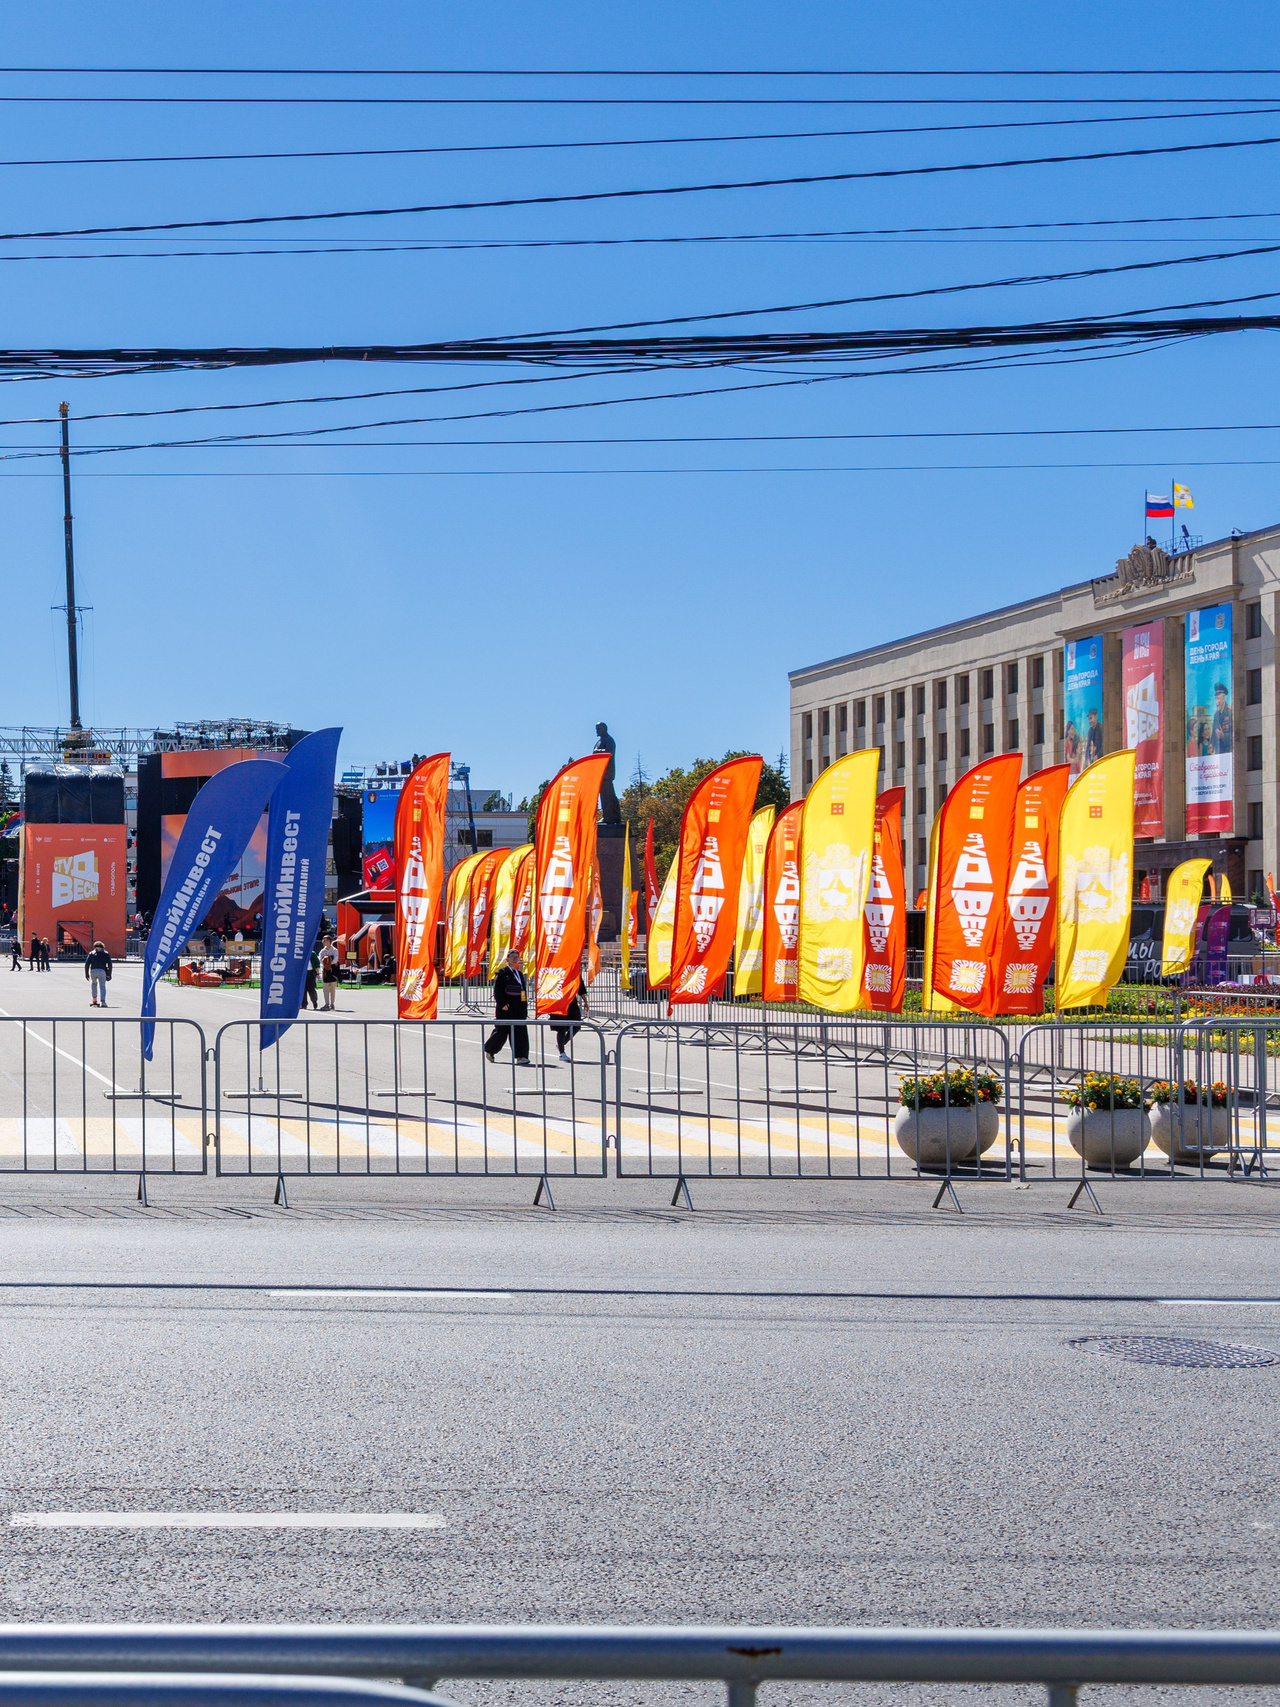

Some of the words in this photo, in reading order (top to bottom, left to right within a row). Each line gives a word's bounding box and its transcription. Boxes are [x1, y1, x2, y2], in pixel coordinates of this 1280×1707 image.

[1204, 641, 1228, 653] ГОРОДА
[1137, 762, 1160, 771] ГОРОДА
[1138, 771, 1152, 780] КРАЯ
[53, 850, 100, 884] СТУД
[402, 836, 428, 894] СТУД
[541, 835, 574, 896] СТУД
[690, 836, 725, 893] СТУД
[774, 860, 800, 904] СТУД
[866, 854, 894, 904] СТУД
[951, 832, 993, 889] СТУД
[1008, 840, 1049, 895] СТУД
[52, 872, 99, 908] ВЕСНА
[267, 810, 301, 1005] ЮгСтройИнвест
[297, 857, 310, 917] КОМПАНИЙ
[293, 919, 307, 960] ГРУППА
[773, 905, 799, 949] ВЕСНА
[864, 904, 895, 953] ВЕСНА
[950, 889, 995, 948] ВЕСНА
[1006, 896, 1050, 951] ВЕСНА
